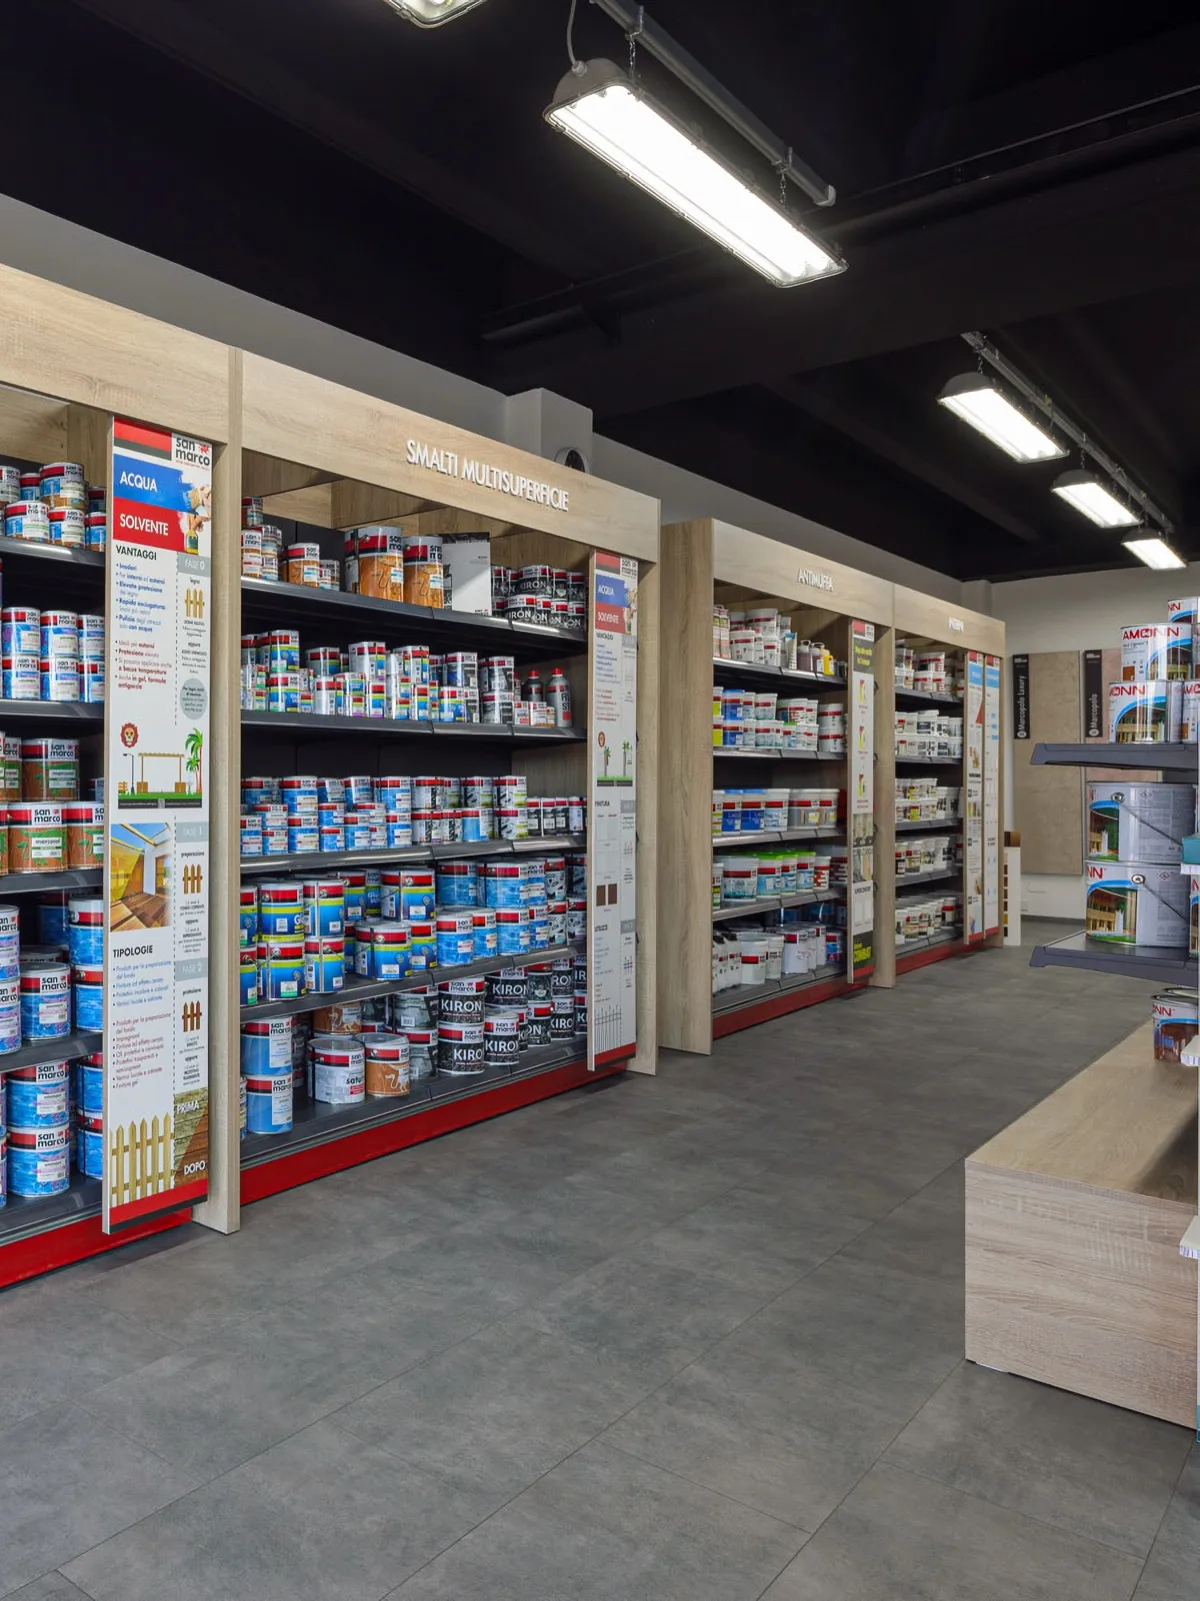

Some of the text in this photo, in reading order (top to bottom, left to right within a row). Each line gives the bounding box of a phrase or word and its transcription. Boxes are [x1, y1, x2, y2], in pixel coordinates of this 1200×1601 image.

[176, 438, 195, 451] san
[176, 448, 210, 466] marco
[120, 471, 157, 492] ACQUA
[406, 440, 568, 511] SMALTI MULTISUPERFICIE
[120, 514, 168, 536] SOLVENTE
[116, 545, 157, 560] VANTAGGI
[598, 584, 614, 596] ACQUA
[598, 612, 619, 624] SOLVENTE
[1123, 627, 1179, 640] AMONN
[1090, 693, 1099, 729] Marcopolo
[113, 945, 153, 958] TIPOLOGIE
[441, 999, 482, 1011] KIRON
[551, 1018, 573, 1030] KIRO
[453, 1049, 482, 1061] KIRO
[177, 1100, 200, 1114] PRIMA
[184, 1160, 206, 1175] DOPO
